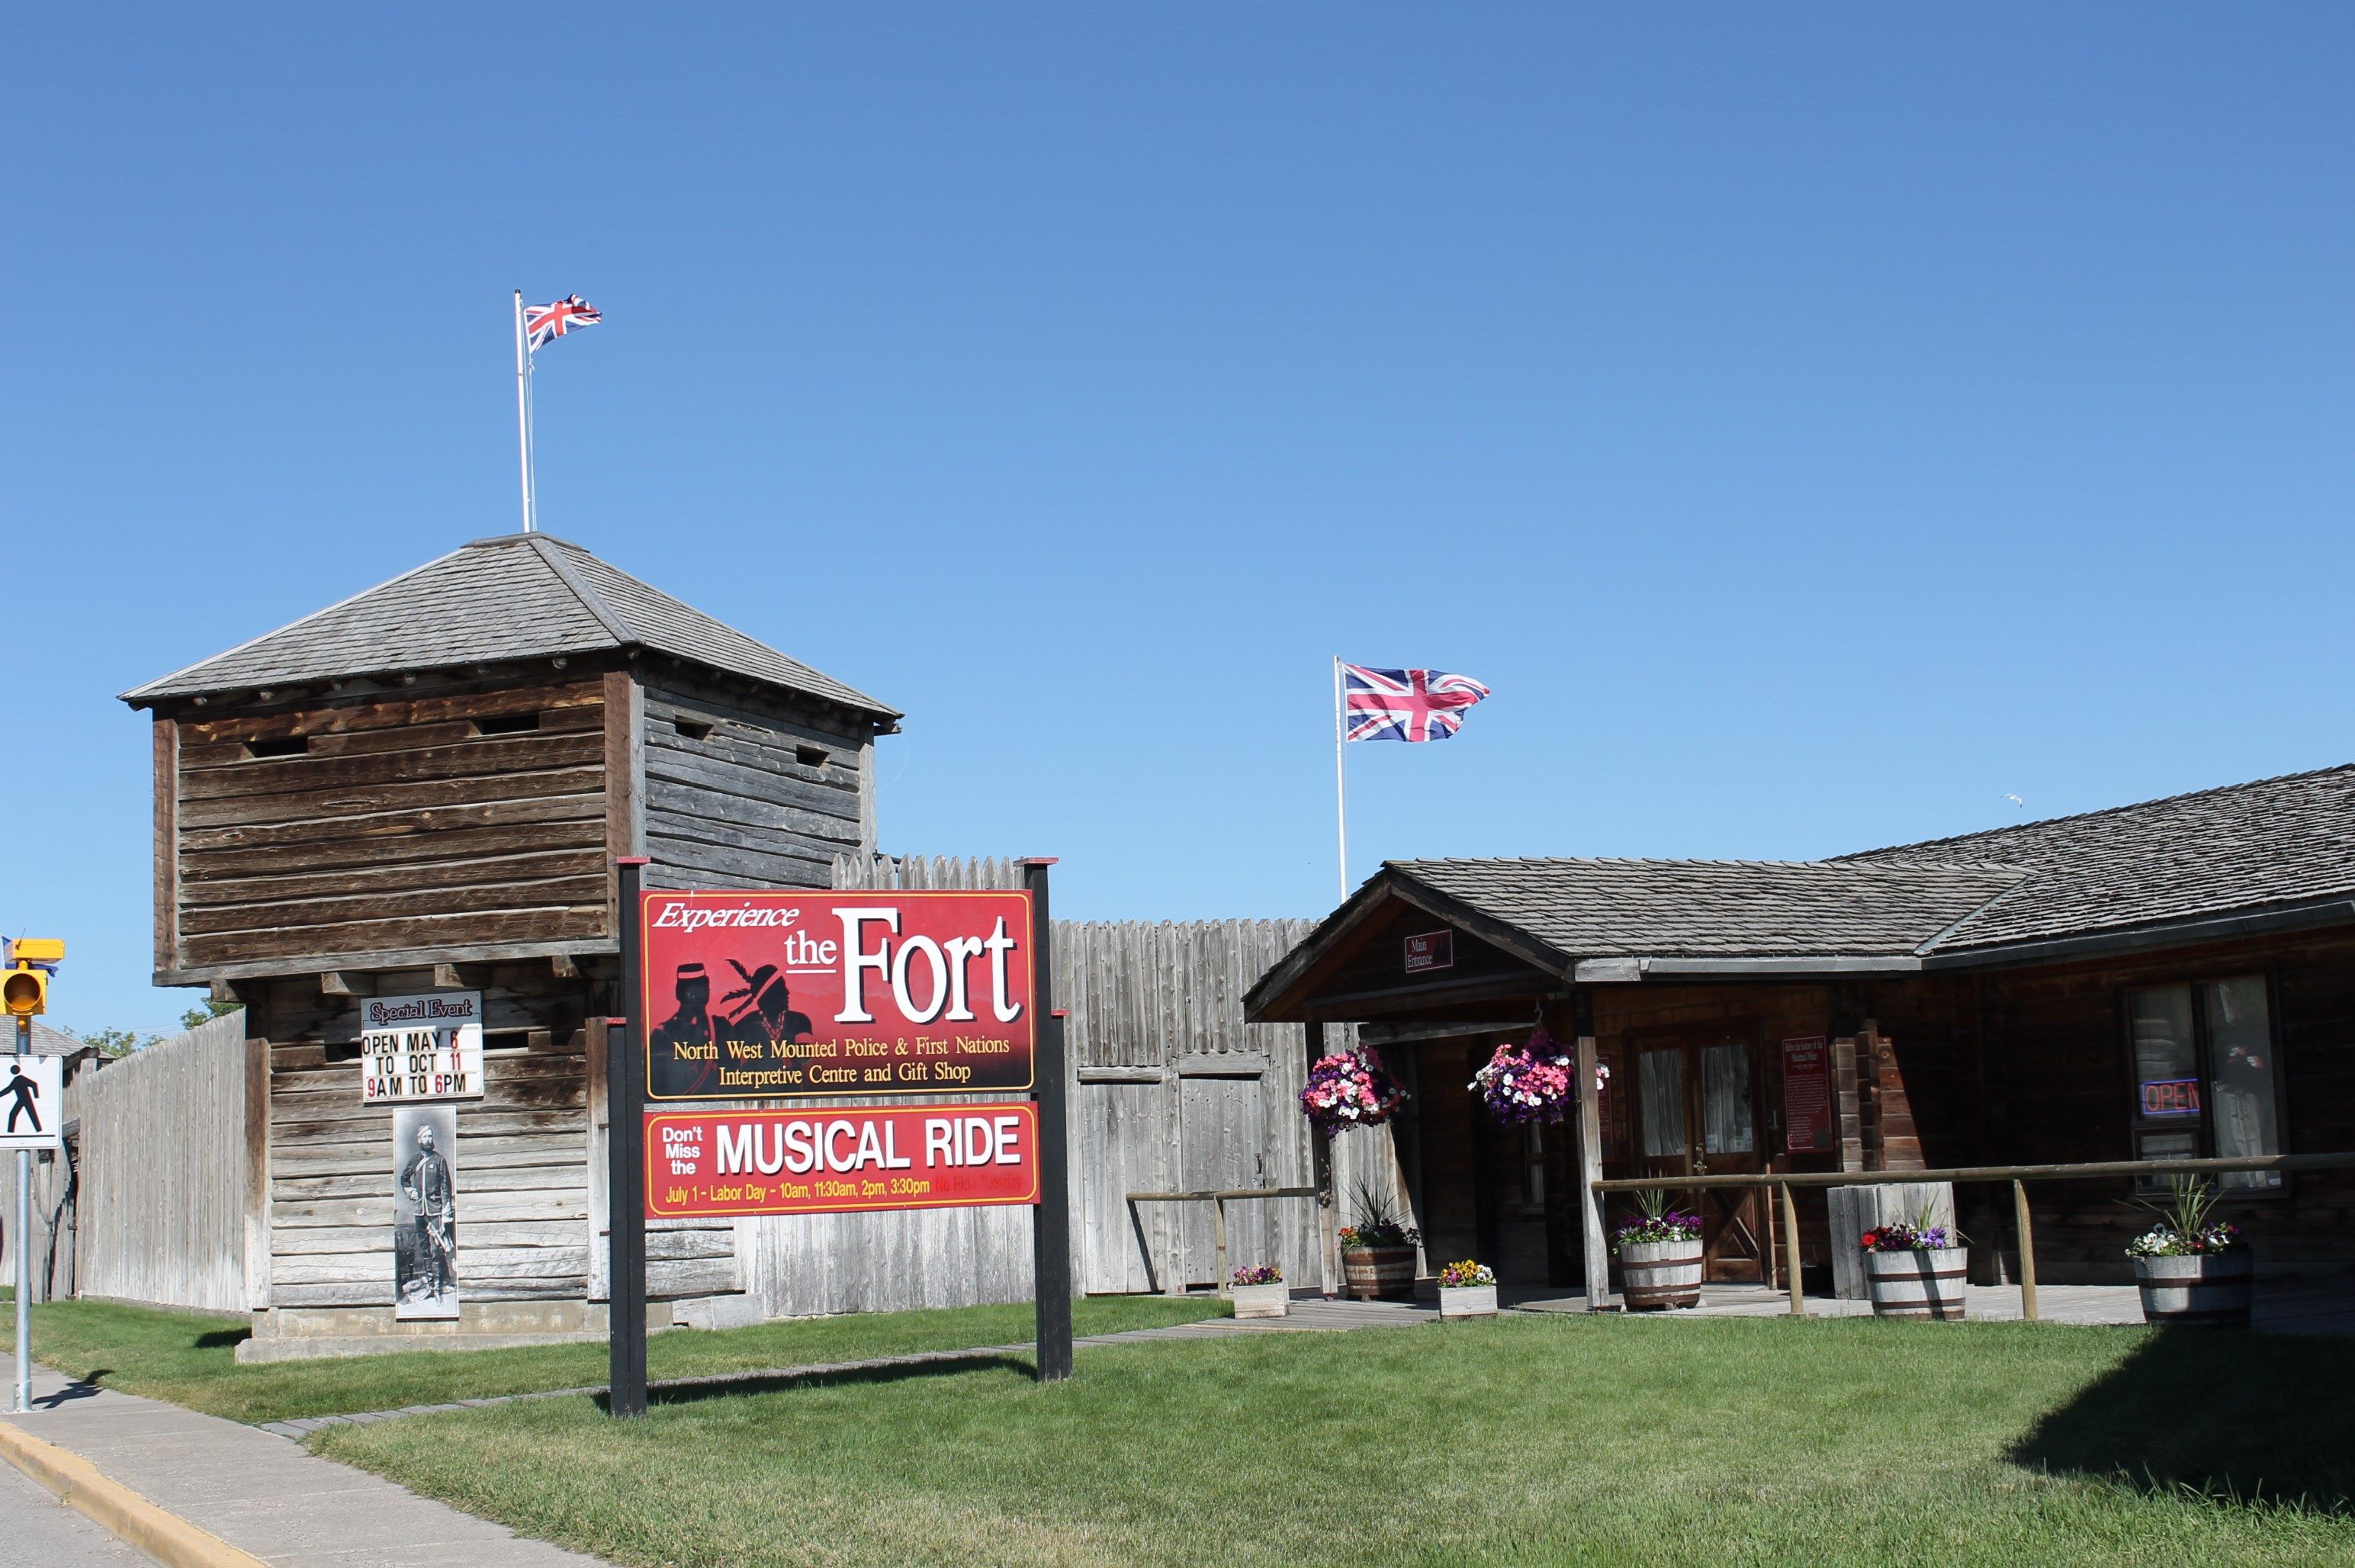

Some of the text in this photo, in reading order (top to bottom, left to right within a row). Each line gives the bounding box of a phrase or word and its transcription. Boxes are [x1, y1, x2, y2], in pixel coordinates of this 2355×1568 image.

[652, 901, 800, 933] Experience
[1412, 938, 1427, 953] Main
[784, 908, 1024, 1025] the Fort
[1408, 955, 1432, 968] Entrance
[371, 998, 473, 1026] Special Event
[362, 1033, 399, 1055] OPEN
[407, 1031, 441, 1052] MAY
[673, 1035, 1010, 1060] North West Mounted Police & First Nations
[376, 1052, 461, 1075] TO OCT 11
[719, 1061, 971, 1089] Interpretive Centre and Gift Shop
[368, 1074, 466, 1097] 9AM TO 6PM
[2146, 1084, 2199, 1110] OPEN
[662, 1126, 703, 1142] Don't
[716, 1116, 1021, 1175] MUSICAL RIDE
[665, 1143, 701, 1159] Miss
[670, 1159, 696, 1175] the
[665, 1185, 688, 1206] July
[692, 1185, 698, 1202] 1
[710, 1184, 743, 1202] Labor
[746, 1183, 766, 1203] Day
[779, 1182, 811, 1200] 10am,
[814, 1178, 858, 1198] 11:30am,
[862, 1179, 888, 1199] 2pm,
[891, 1178, 930, 1197] 3:30pm
